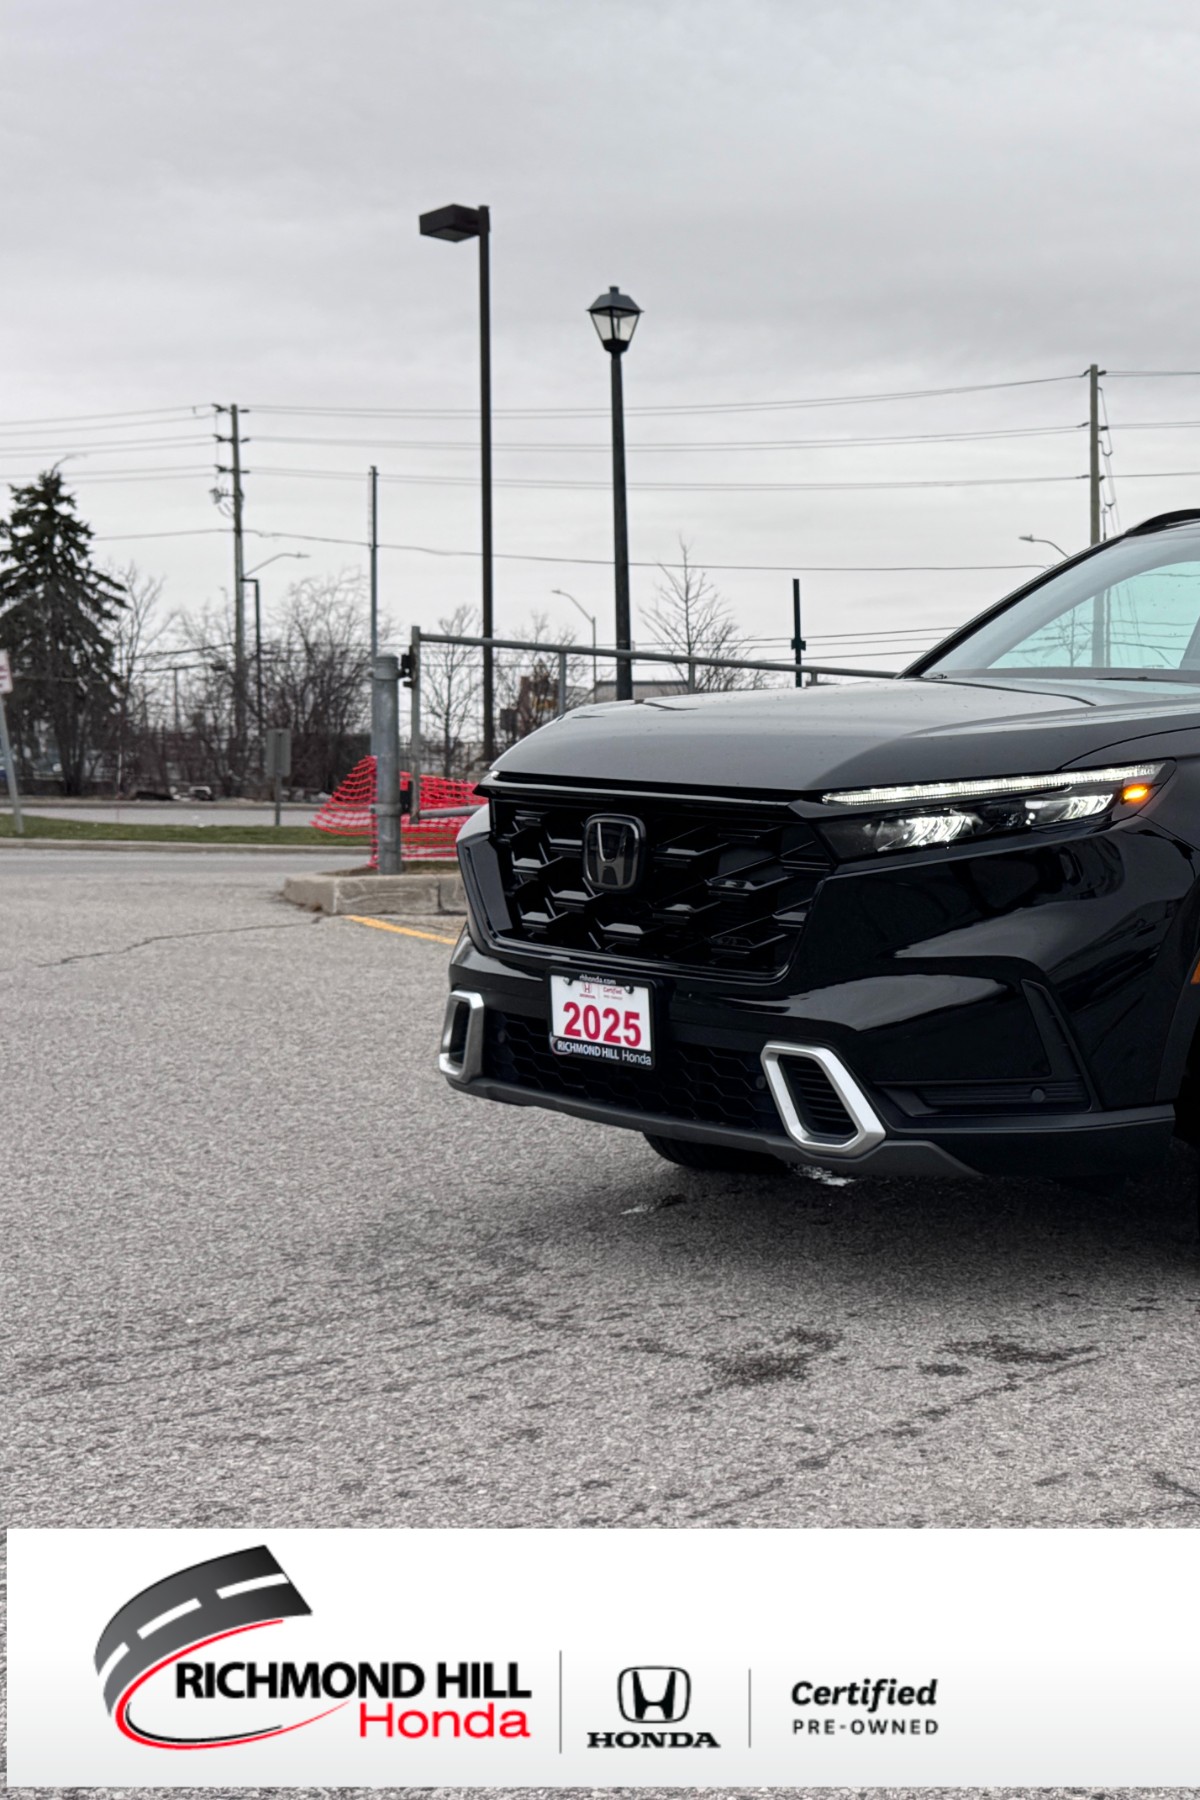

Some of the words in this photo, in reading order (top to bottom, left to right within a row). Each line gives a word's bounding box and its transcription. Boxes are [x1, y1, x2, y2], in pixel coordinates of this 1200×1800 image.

[563, 1001, 642, 1047] 2025
[557, 1040, 601, 1057] RICHMOND
[602, 1047, 620, 1060] HILL
[622, 1051, 652, 1066] Honda
